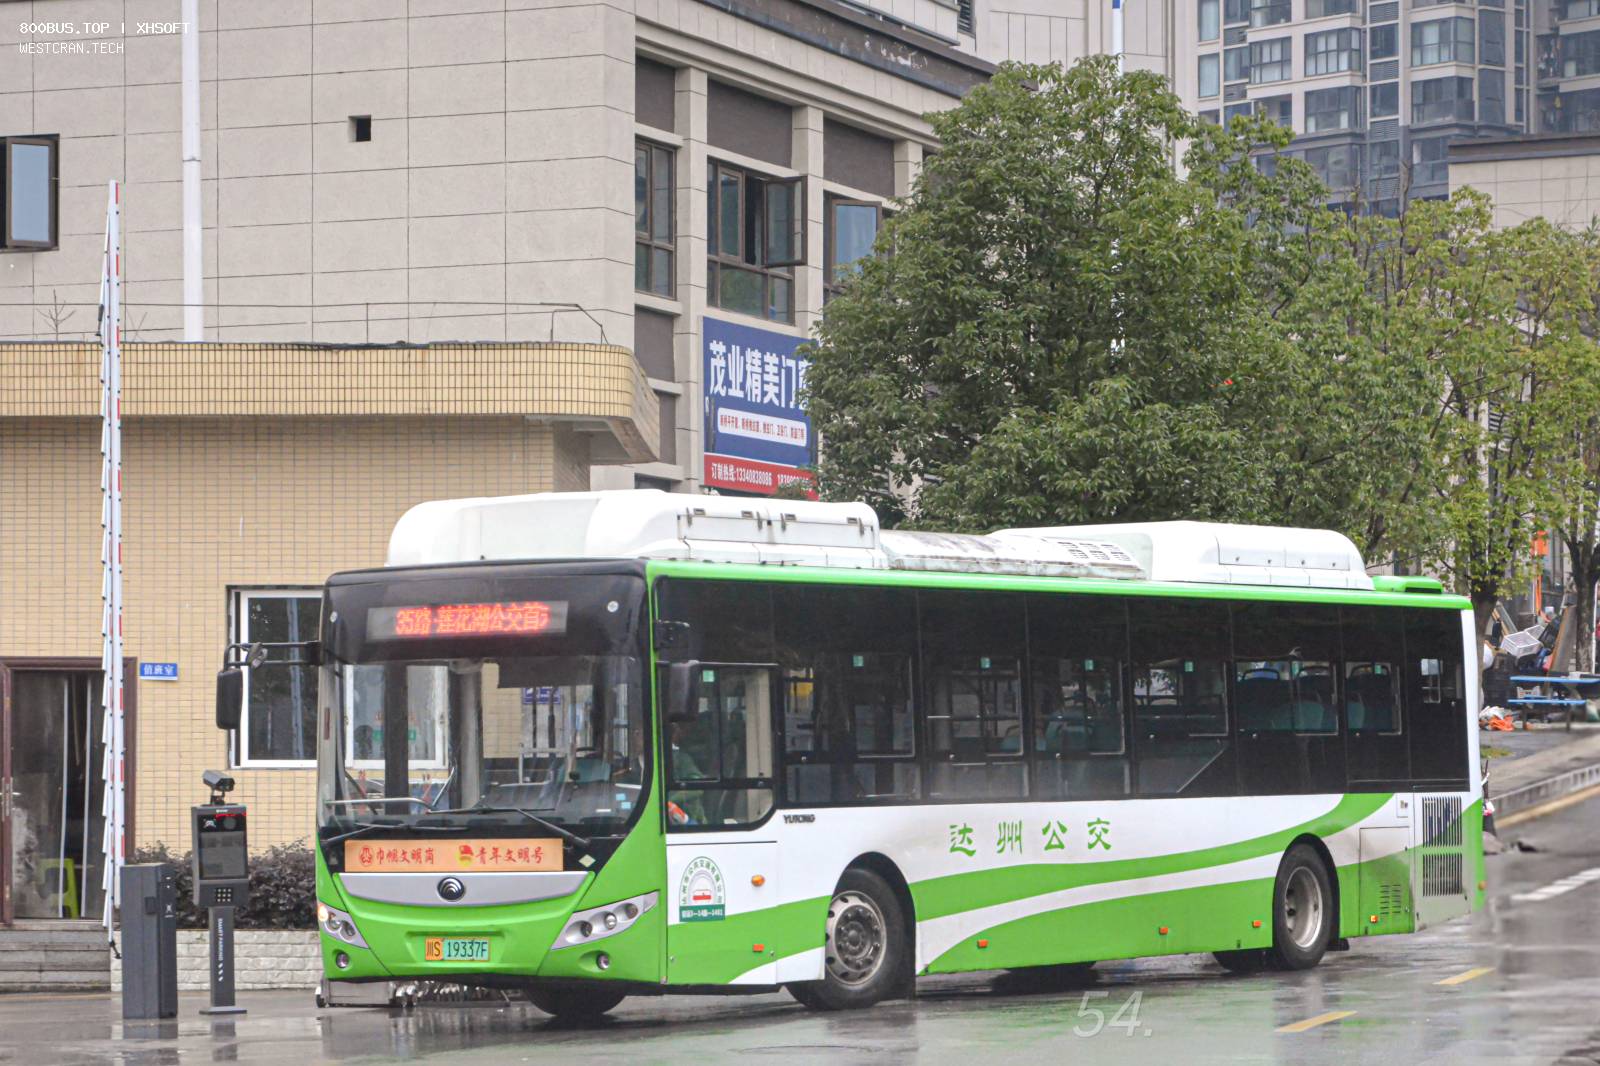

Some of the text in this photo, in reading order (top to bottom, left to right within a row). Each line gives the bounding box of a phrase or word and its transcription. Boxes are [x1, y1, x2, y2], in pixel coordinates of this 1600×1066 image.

[783, 814, 816, 824] YUTONG
[949, 817, 1112, 857] 达州公交
[376, 847, 436, 865] 巾帼文明岗
[475, 846, 545, 865] 青年文明号
[446, 942, 488, 959] 19337F
